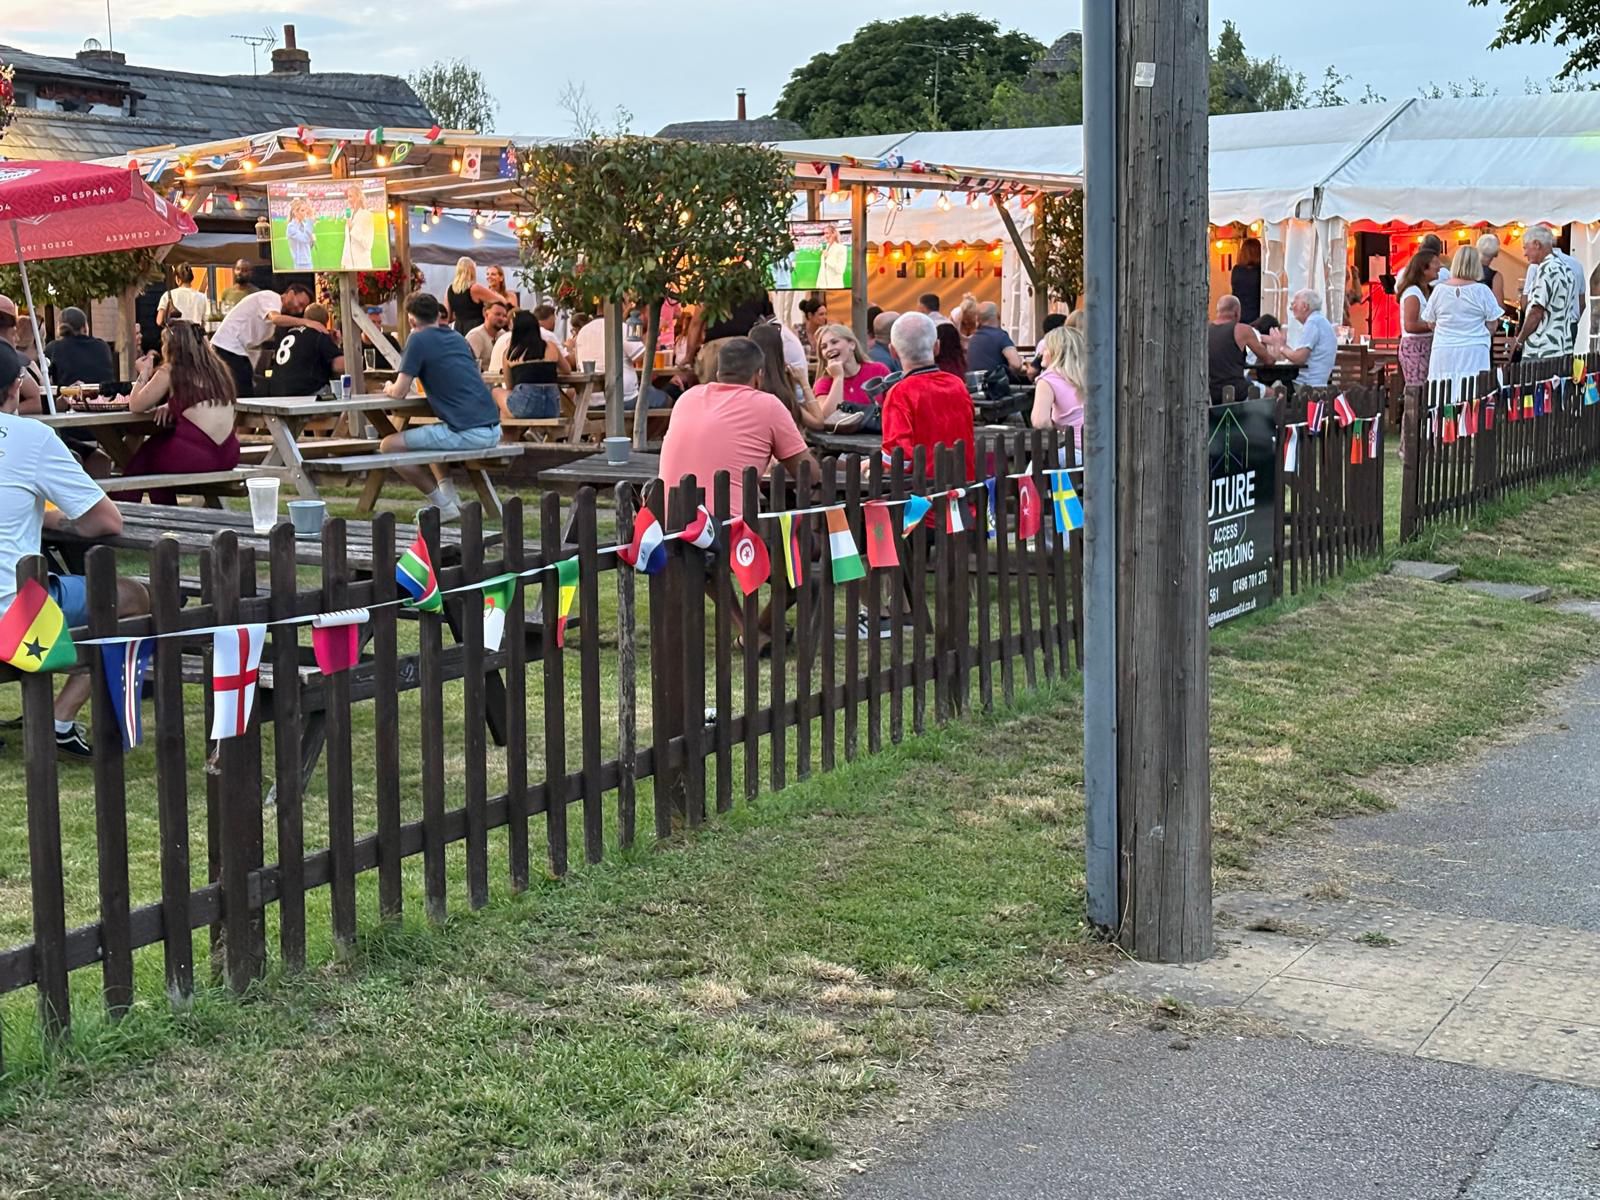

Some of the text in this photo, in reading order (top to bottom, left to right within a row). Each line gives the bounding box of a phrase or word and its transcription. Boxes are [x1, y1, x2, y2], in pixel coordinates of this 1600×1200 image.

[53, 186, 114, 203] DE ESPAÑA
[276, 334, 295, 365] 8
[1208, 470, 1255, 518] UTURE
[1213, 522, 1238, 544] ACCESS
[1208, 540, 1254, 574] AFFOLDING
